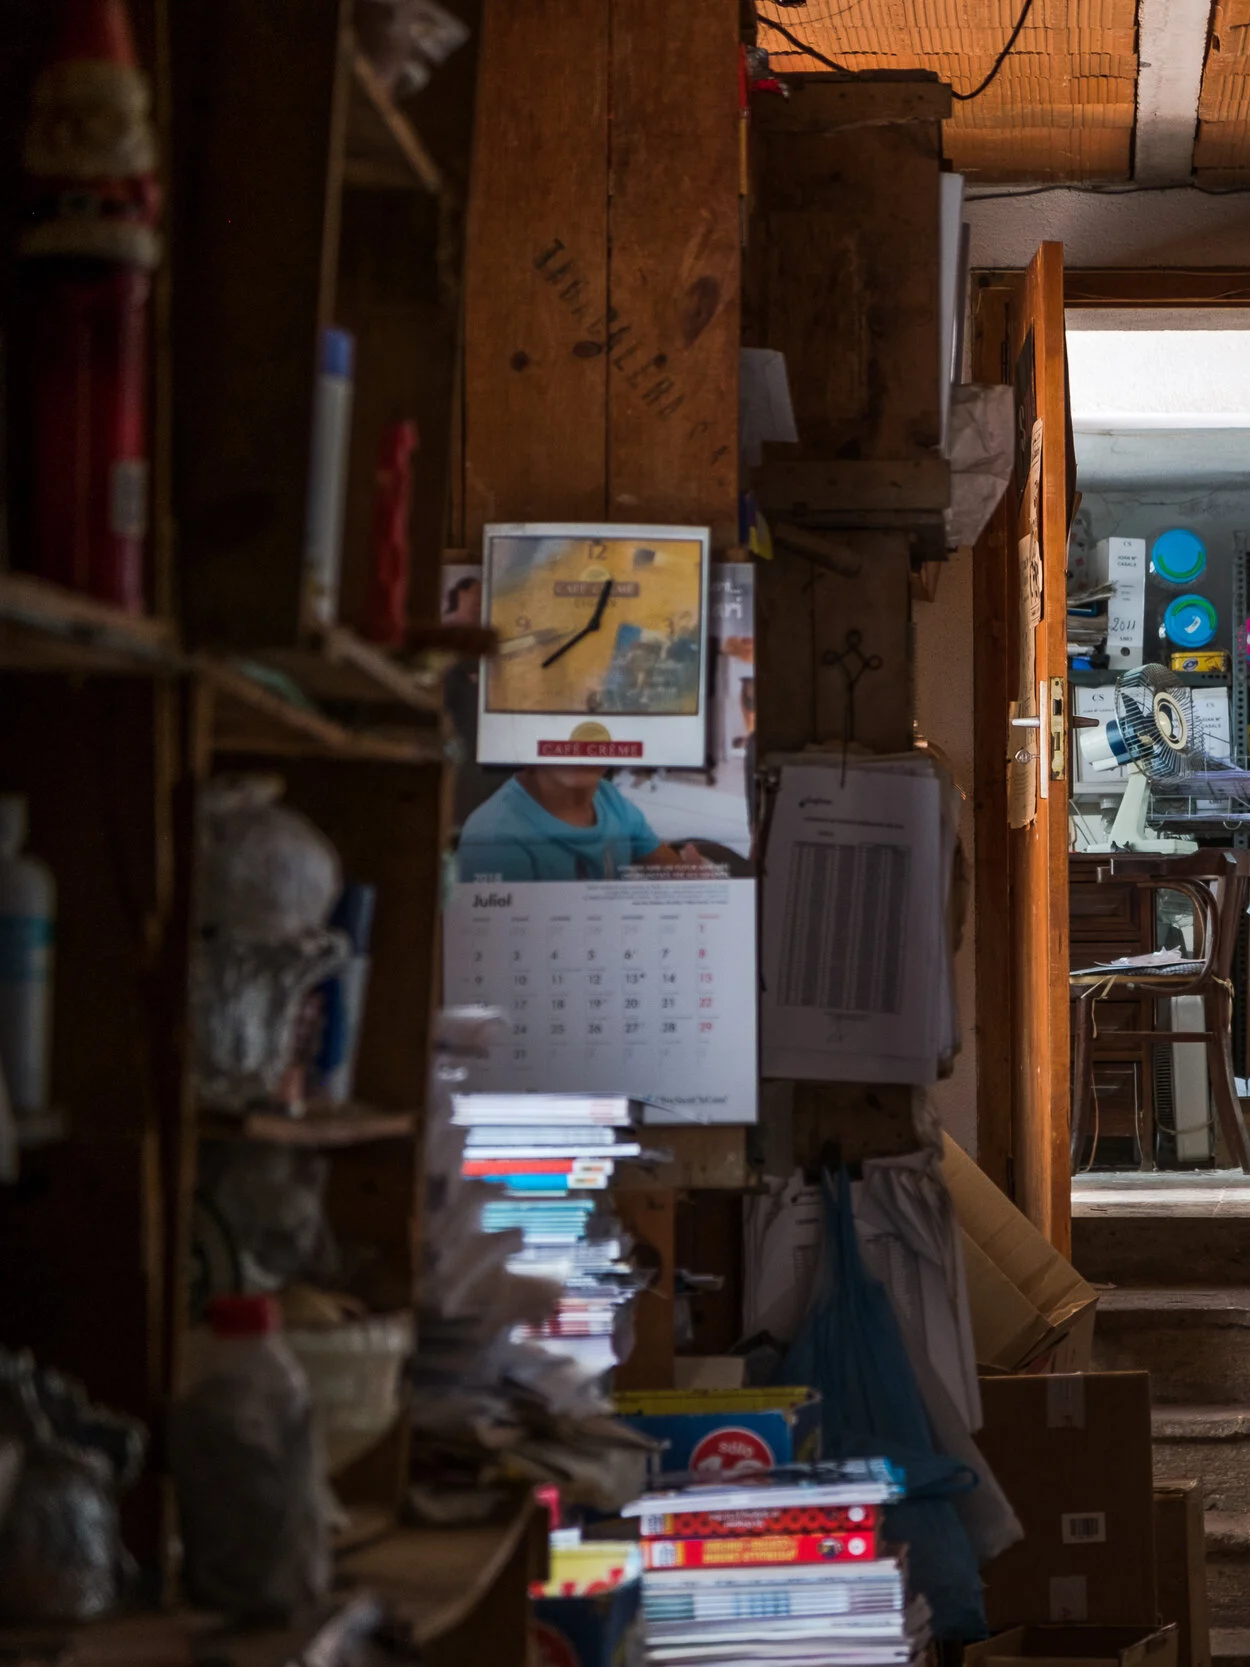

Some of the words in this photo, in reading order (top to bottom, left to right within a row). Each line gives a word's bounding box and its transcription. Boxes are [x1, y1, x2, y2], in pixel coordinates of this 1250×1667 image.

[586, 544, 607, 561] 12
[556, 582, 587, 595] CAFÉ
[592, 582, 634, 595] CME
[1111, 617, 1136, 632] 2011
[1092, 693, 1105, 702] CS
[541, 742, 580, 756] CAFÉ
[586, 742, 639, 757] CRÈME
[472, 893, 513, 908] Juliol
[514, 976, 527, 986] 10
[551, 975, 563, 985] 11
[588, 975, 601, 985] 12
[626, 974, 639, 985] 13
[662, 974, 676, 984] 14
[700, 973, 712, 983] 15
[514, 1000, 527, 1010] 17
[551, 1000, 564, 1010] 18
[588, 999, 601, 1009] 19
[625, 998, 639, 1009] 20
[662, 998, 675, 1008] 21
[699, 998, 712, 1008] 22
[513, 1024, 527, 1034] 24
[550, 1024, 564, 1034] 25
[587, 1023, 602, 1034] 26
[625, 1023, 639, 1033] 27
[662, 1022, 676, 1033] 28
[699, 1022, 713, 1032] 29
[513, 1050, 526, 1060] 31
